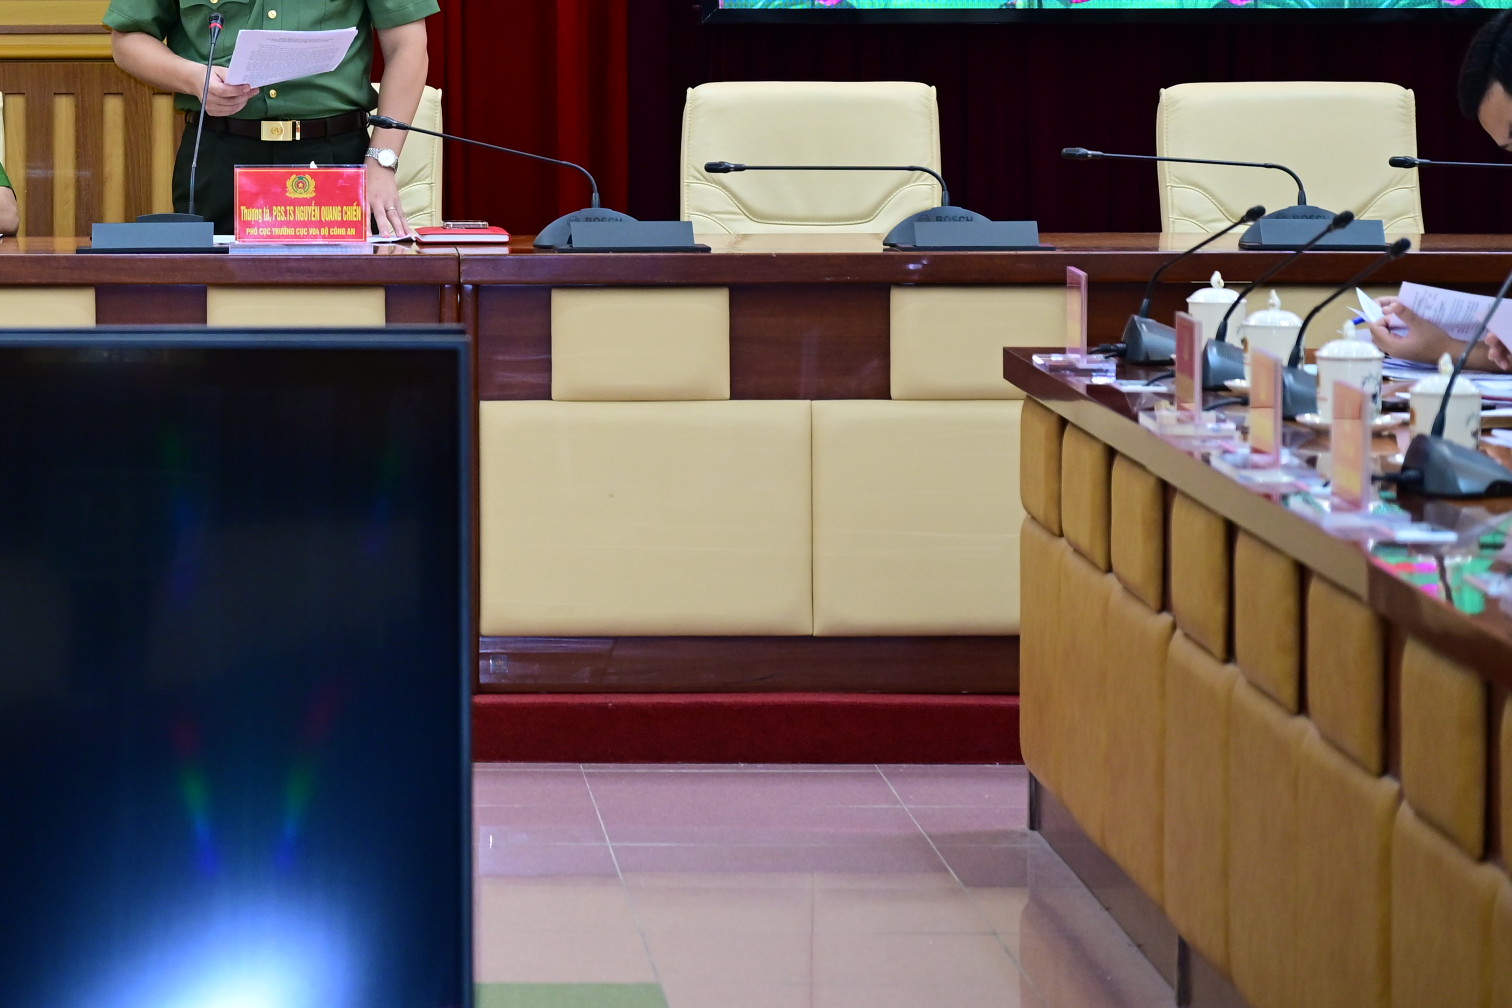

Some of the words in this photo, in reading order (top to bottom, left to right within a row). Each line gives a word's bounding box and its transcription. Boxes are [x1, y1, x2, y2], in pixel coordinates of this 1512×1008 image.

[240, 205, 263, 224] Thượng
[272, 205, 294, 221] PGS.TS
[295, 200, 320, 221] NGUYỄN
[321, 205, 342, 223] QUANG
[342, 201, 362, 221] CHIẾN
[246, 226, 258, 235] PHÓ
[296, 227, 308, 237] CỤC
[330, 225, 347, 235] CÔNG
[347, 227, 356, 235] AN
